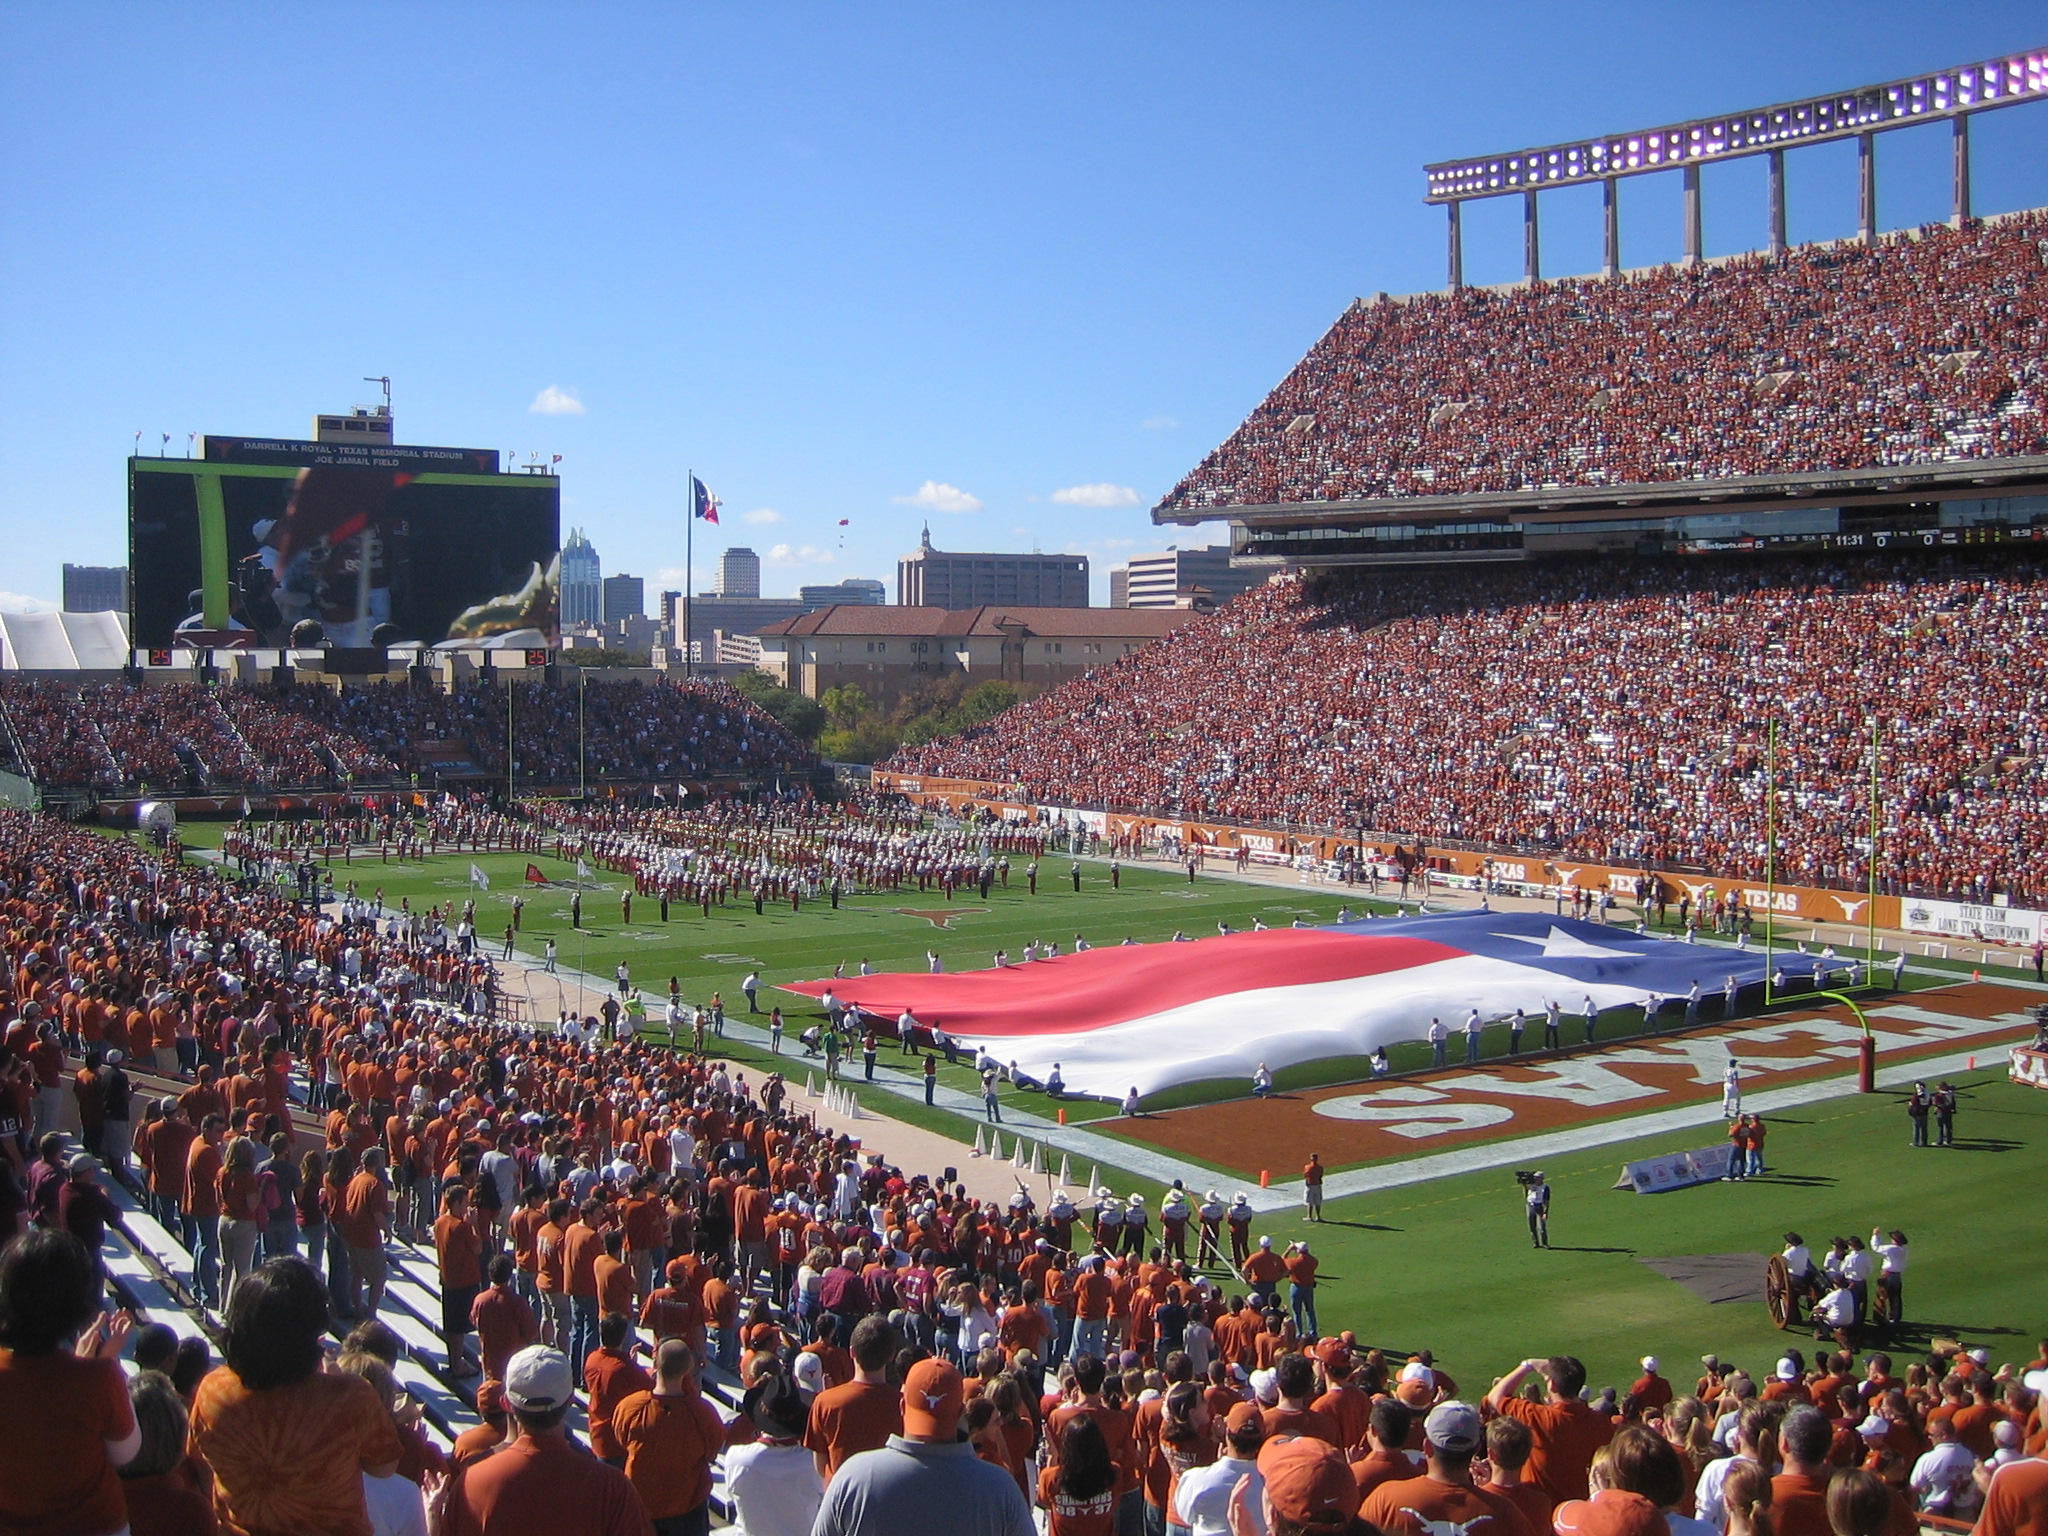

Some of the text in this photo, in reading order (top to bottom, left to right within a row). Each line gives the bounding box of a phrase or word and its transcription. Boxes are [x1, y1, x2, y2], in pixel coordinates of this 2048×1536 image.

[243, 441, 288, 451] DARRELL
[291, 444, 298, 452] K
[301, 444, 332, 454] ROYAL
[338, 446, 369, 456] TEXAS
[371, 448, 420, 458] MEMORIAL
[422, 450, 463, 460] STADIUM
[314, 455, 400, 467] JOE JAMAIL FIELD
[1836, 534, 1863, 546] 11:31
[1876, 536, 1886, 548] 0
[1923, 534, 1934, 546] 0
[151, 649, 170, 664] 25
[529, 650, 544, 664] 25
[1240, 833, 1274, 850] TEXAS
[1743, 888, 1798, 912] TEXAS
[1959, 905, 2006, 923] STATE FARM
[1937, 917, 1958, 932] LONE
[1984, 923, 2030, 941] SHOWDOWN
[1007, 1248, 1022, 1263] 10
[1095, 1501, 1112, 1516] 37
